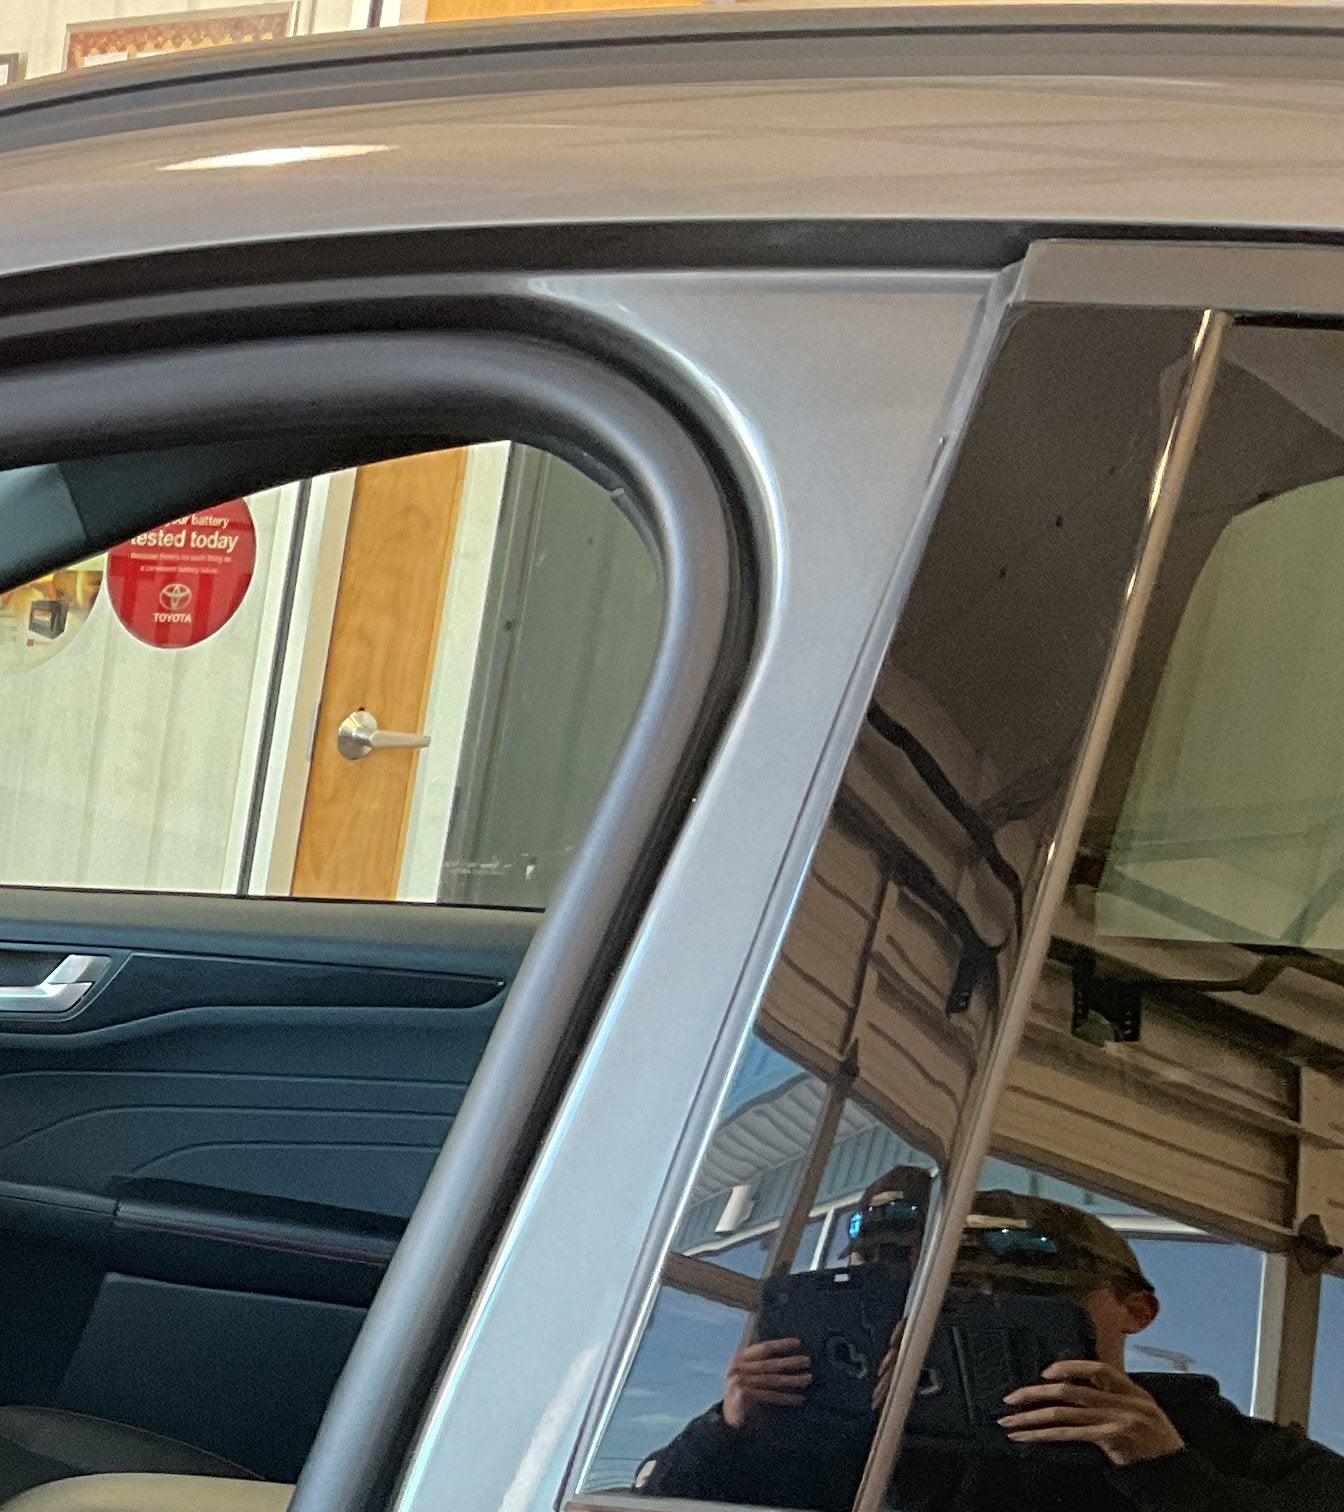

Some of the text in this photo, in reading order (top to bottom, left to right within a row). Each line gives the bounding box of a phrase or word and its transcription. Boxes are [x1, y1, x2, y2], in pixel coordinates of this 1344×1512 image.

[191, 514, 230, 529] battery
[190, 531, 238, 553] today
[153, 612, 192, 623] TOYOTA
